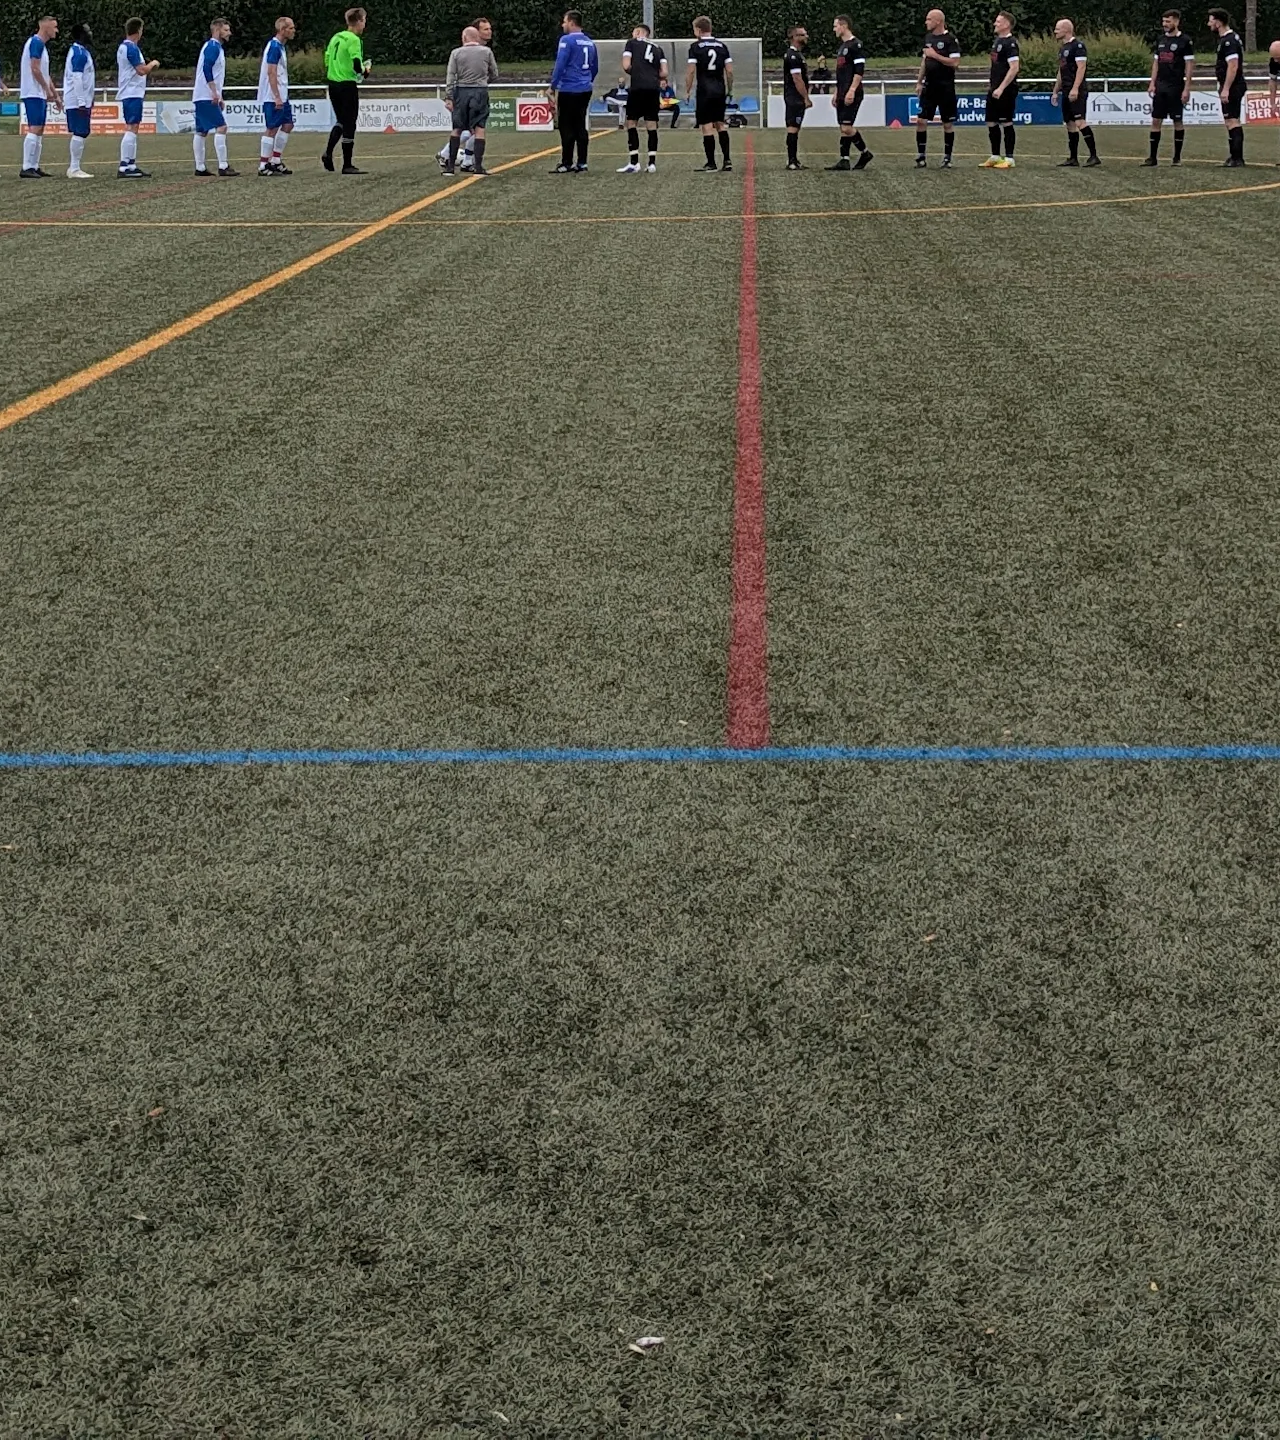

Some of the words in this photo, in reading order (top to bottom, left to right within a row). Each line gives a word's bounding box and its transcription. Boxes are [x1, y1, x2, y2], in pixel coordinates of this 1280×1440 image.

[333, 42, 340, 61] 1
[582, 47, 590, 70] 1
[645, 44, 655, 63] 4
[707, 49, 718, 71] 2
[359, 104, 411, 112] estaurant
[489, 101, 510, 110] sche
[956, 98, 987, 109] R-Ba
